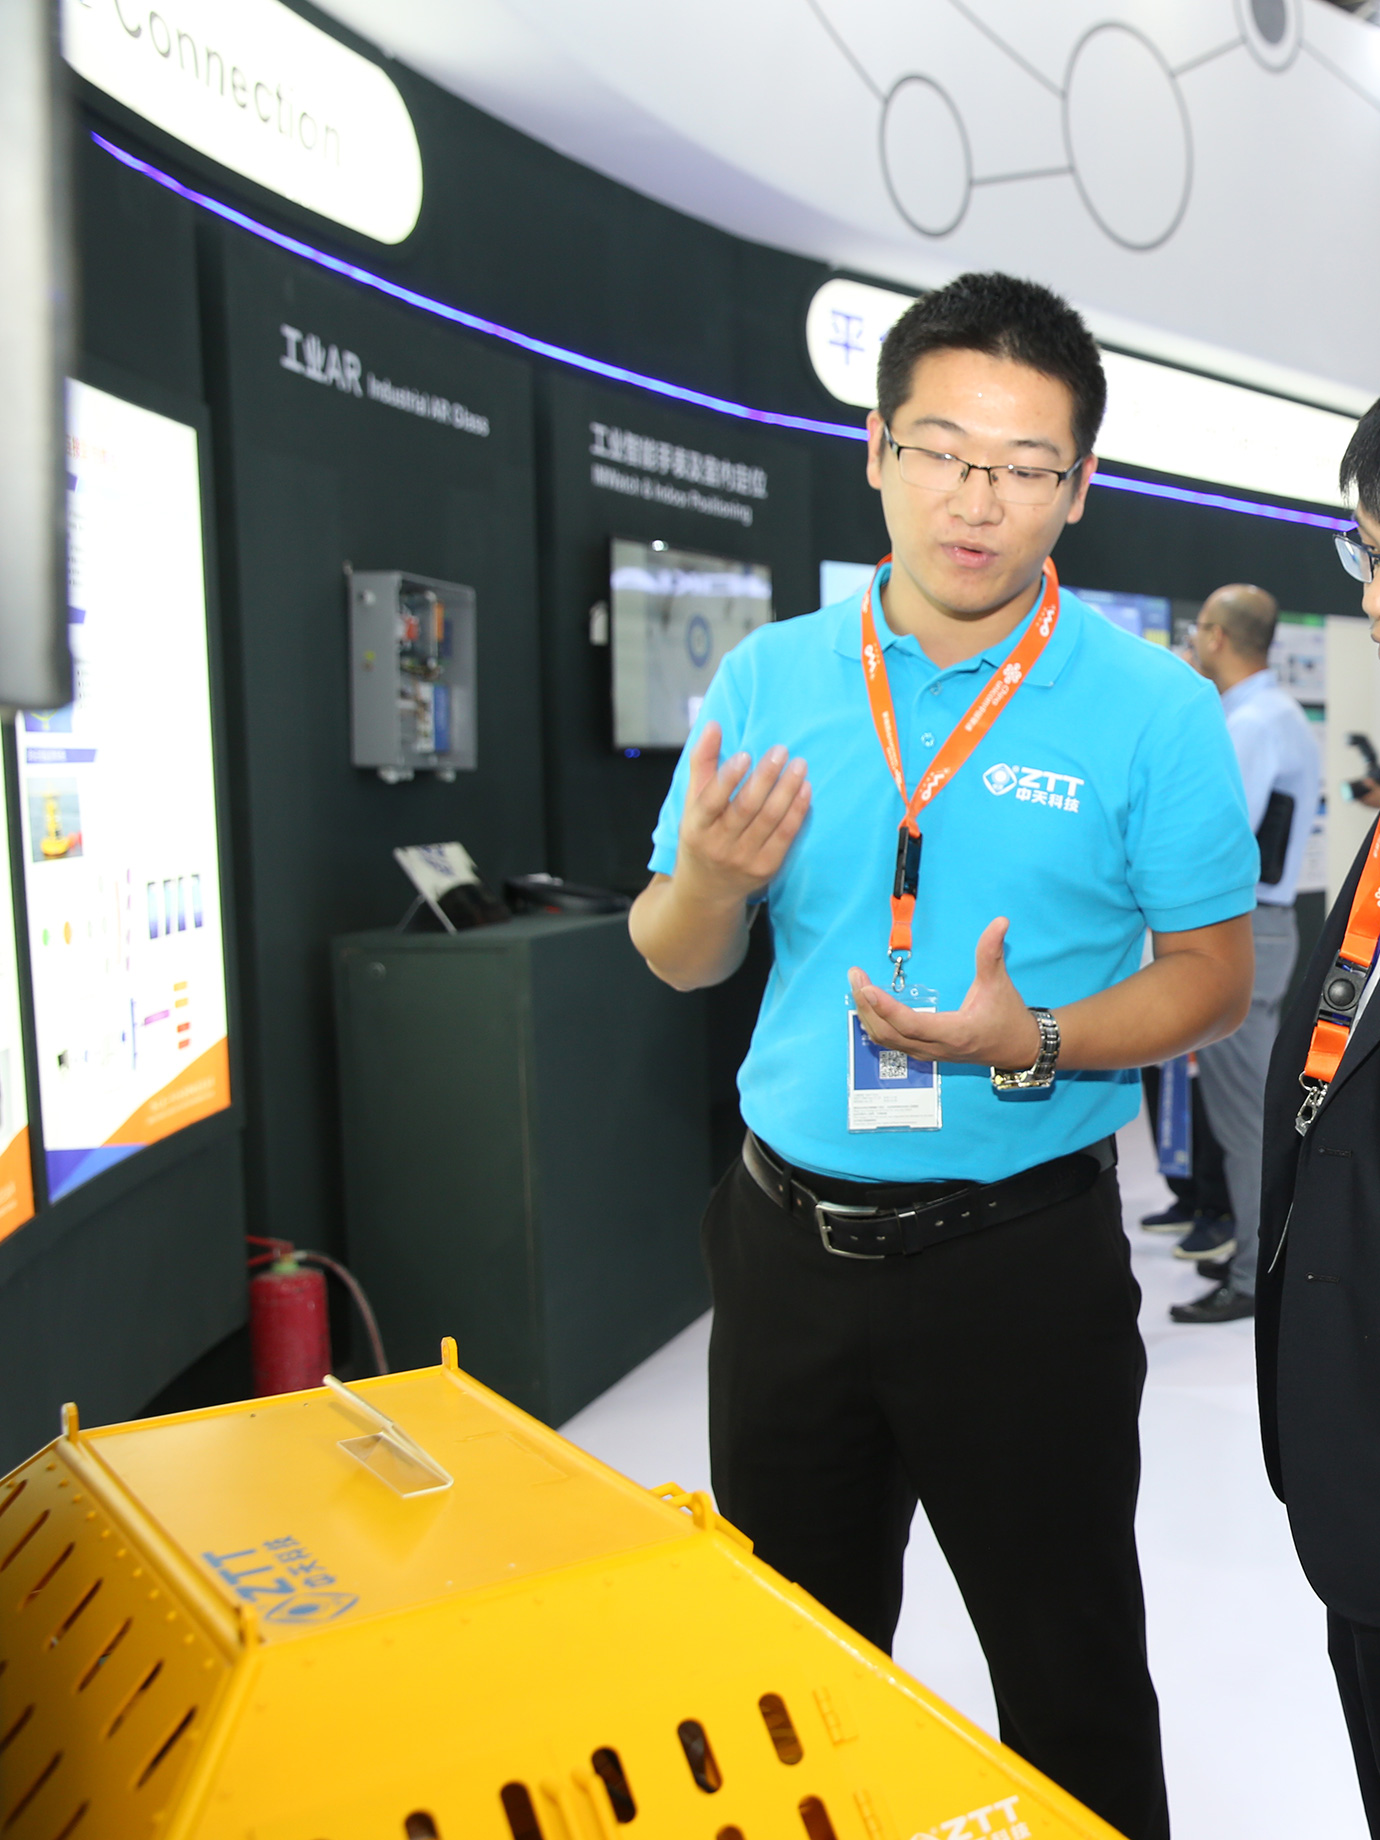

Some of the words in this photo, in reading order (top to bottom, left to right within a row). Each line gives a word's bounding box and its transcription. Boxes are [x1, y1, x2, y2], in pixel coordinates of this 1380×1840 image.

[1018, 766, 1085, 797] ZTT
[1015, 787, 1080, 813] 中天科技
[940, 1794, 1020, 1840] ZTT
